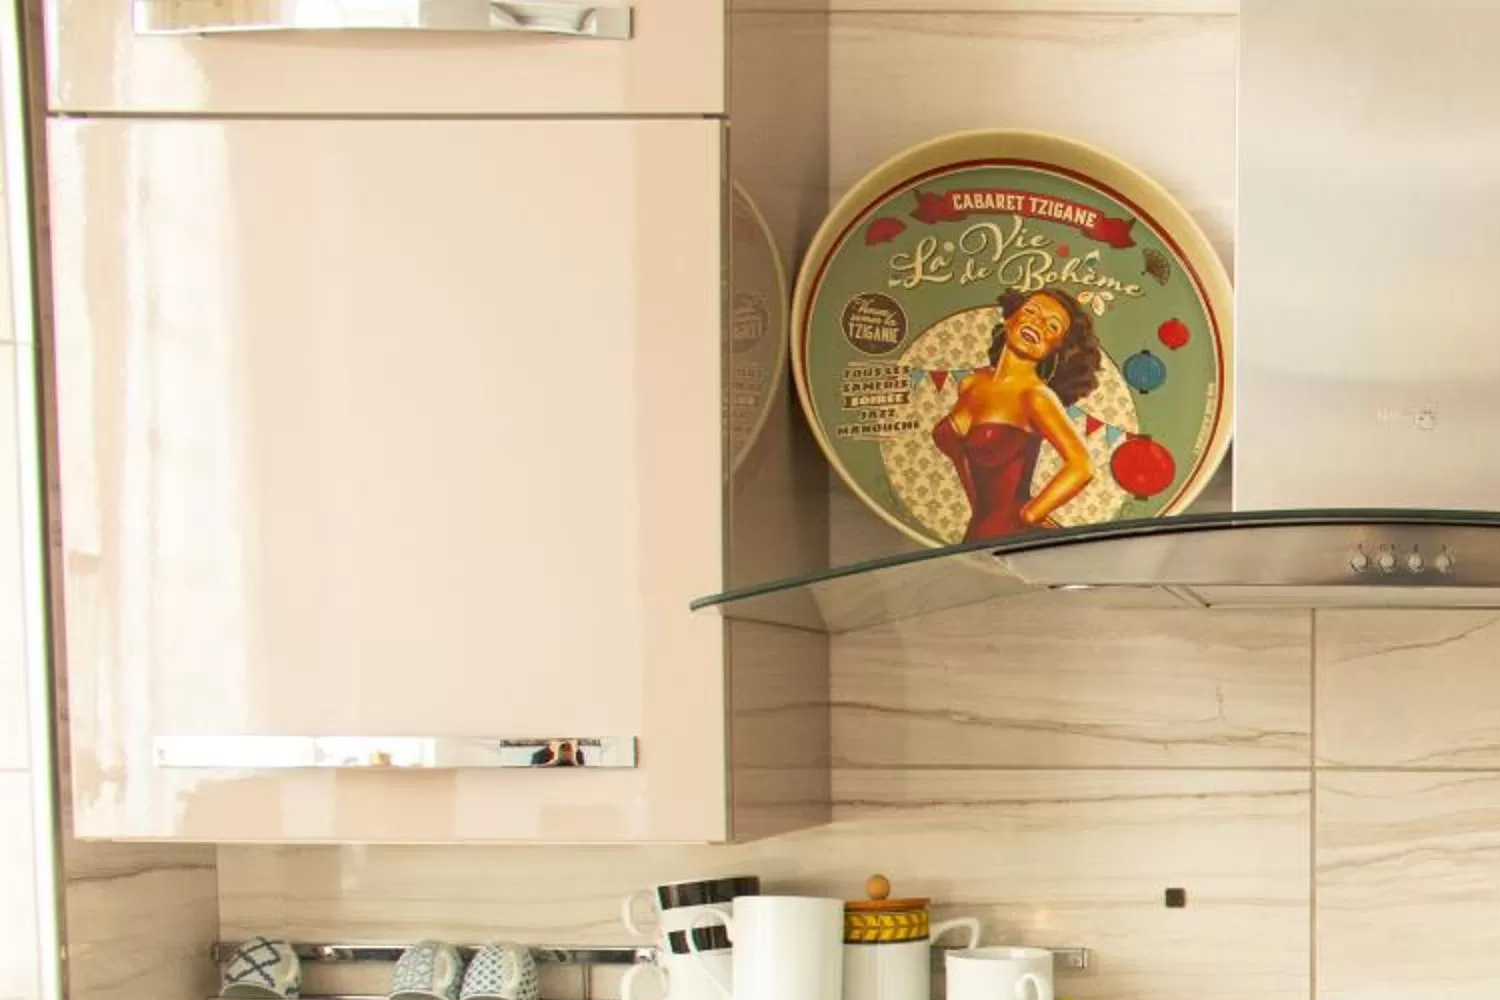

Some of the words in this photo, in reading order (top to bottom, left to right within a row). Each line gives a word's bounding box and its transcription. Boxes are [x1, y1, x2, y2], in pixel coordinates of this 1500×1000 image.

[952, 193, 1025, 212] CABARET
[1029, 196, 1098, 229] TZIGANE
[888, 236, 953, 288] La
[959, 214, 1050, 262] Vie
[960, 259, 993, 286] de
